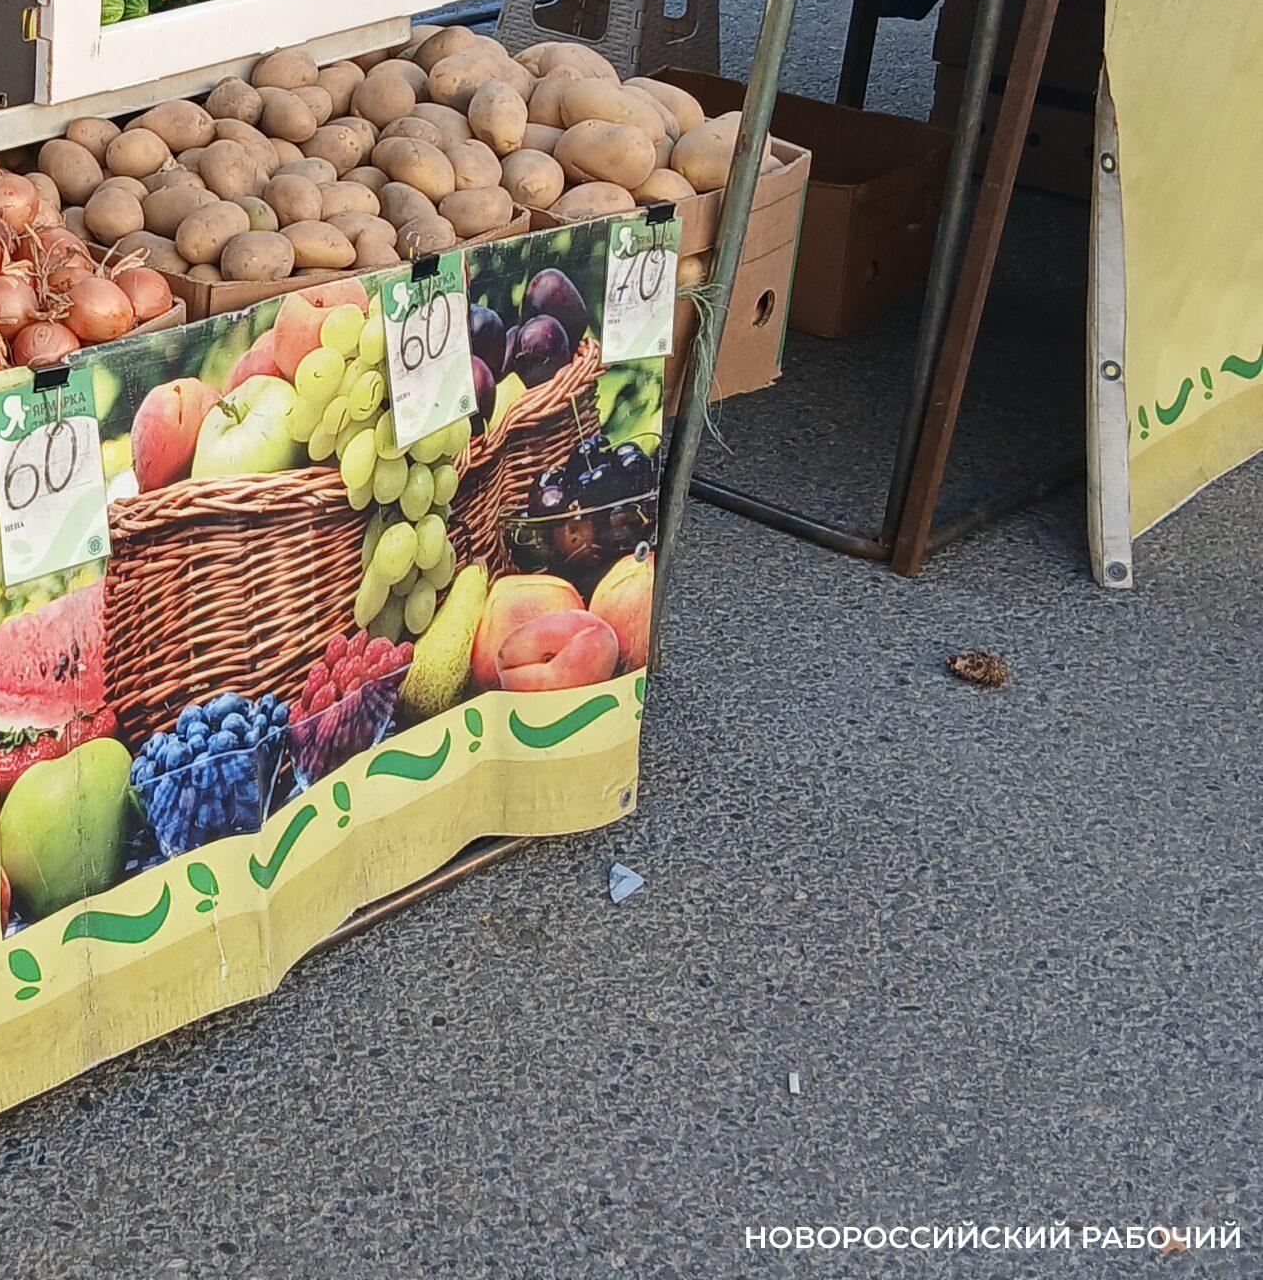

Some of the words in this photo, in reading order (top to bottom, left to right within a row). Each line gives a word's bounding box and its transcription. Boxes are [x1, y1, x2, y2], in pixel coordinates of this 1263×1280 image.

[400, 290, 451, 371] 60
[32, 391, 87, 417] ЯРМРКА
[4, 420, 77, 510] 60
